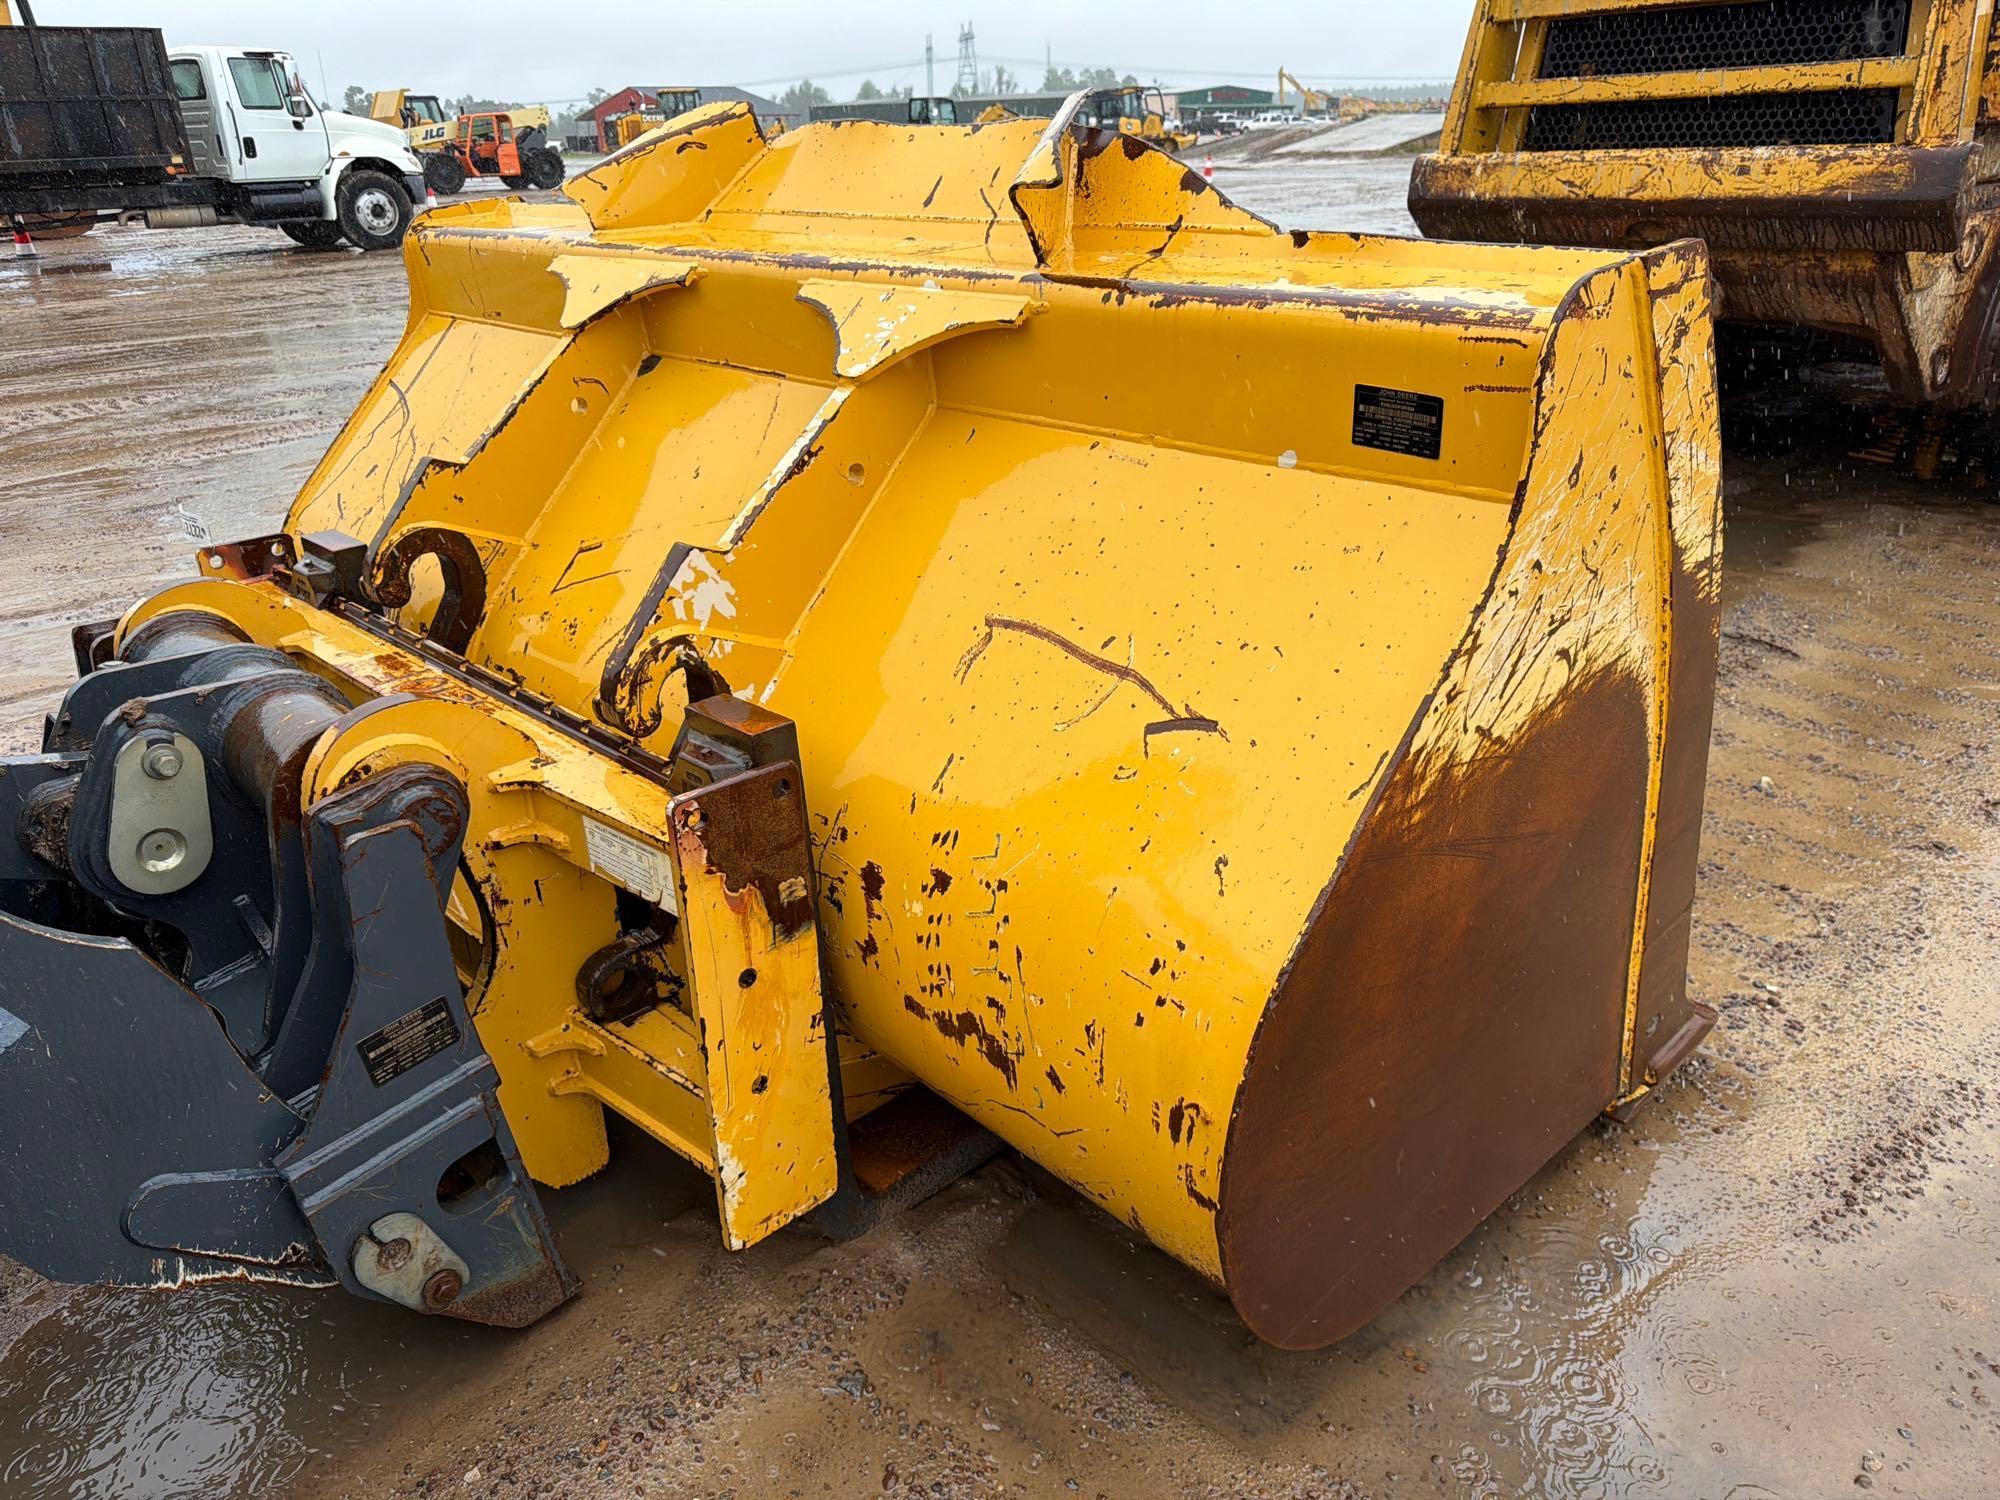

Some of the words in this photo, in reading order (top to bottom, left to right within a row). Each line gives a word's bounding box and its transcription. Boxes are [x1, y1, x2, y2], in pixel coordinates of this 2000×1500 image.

[642, 114, 665, 122] DEERE
[422, 126, 445, 141] JLG
[1379, 389, 1395, 397] JOHN
[1397, 391, 1418, 400] DEERE
[383, 1022, 400, 1034] JOHN
[400, 1009, 422, 1023] DEERE
